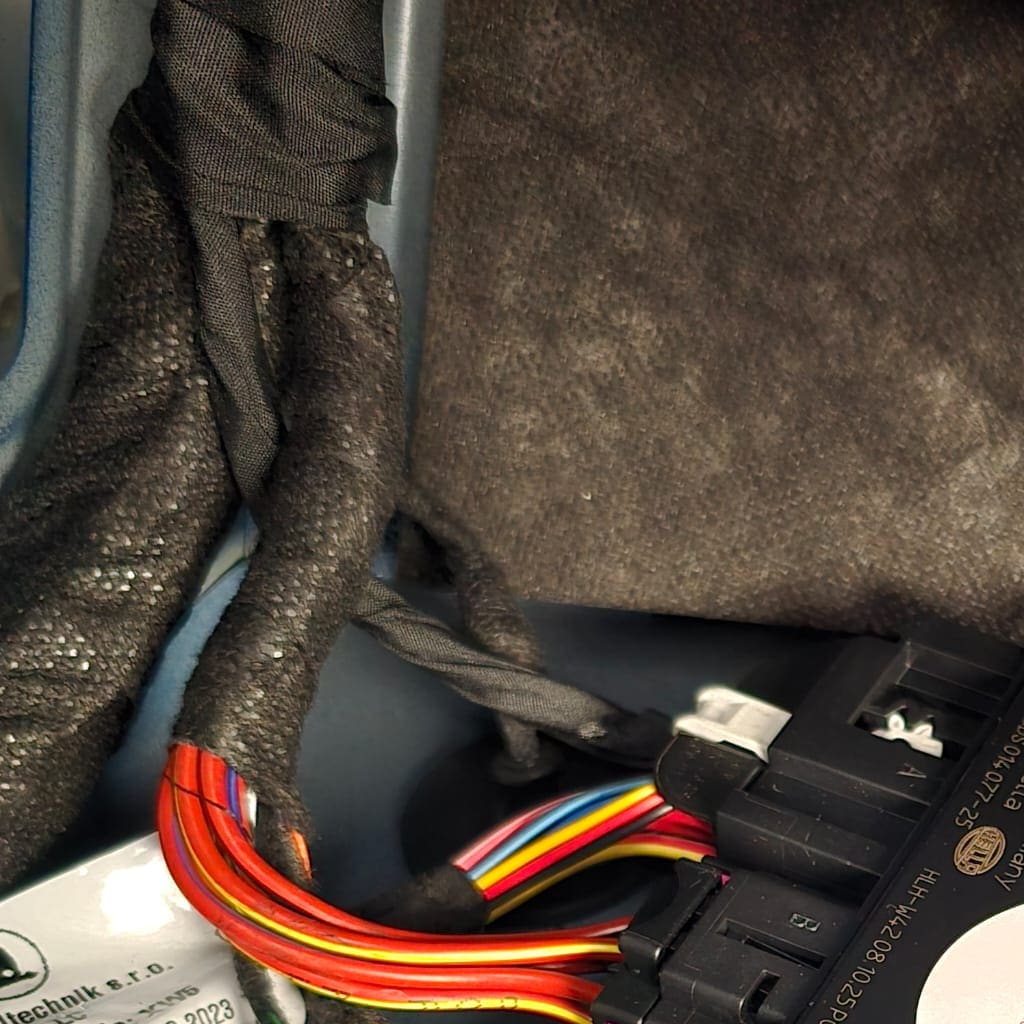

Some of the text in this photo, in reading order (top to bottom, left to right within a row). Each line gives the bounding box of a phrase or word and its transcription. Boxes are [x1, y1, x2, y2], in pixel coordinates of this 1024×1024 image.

[992, 744, 1021, 769] 014
[895, 762, 927, 778] A
[879, 867, 941, 939] HLH-W42
[789, 912, 821, 931] B
